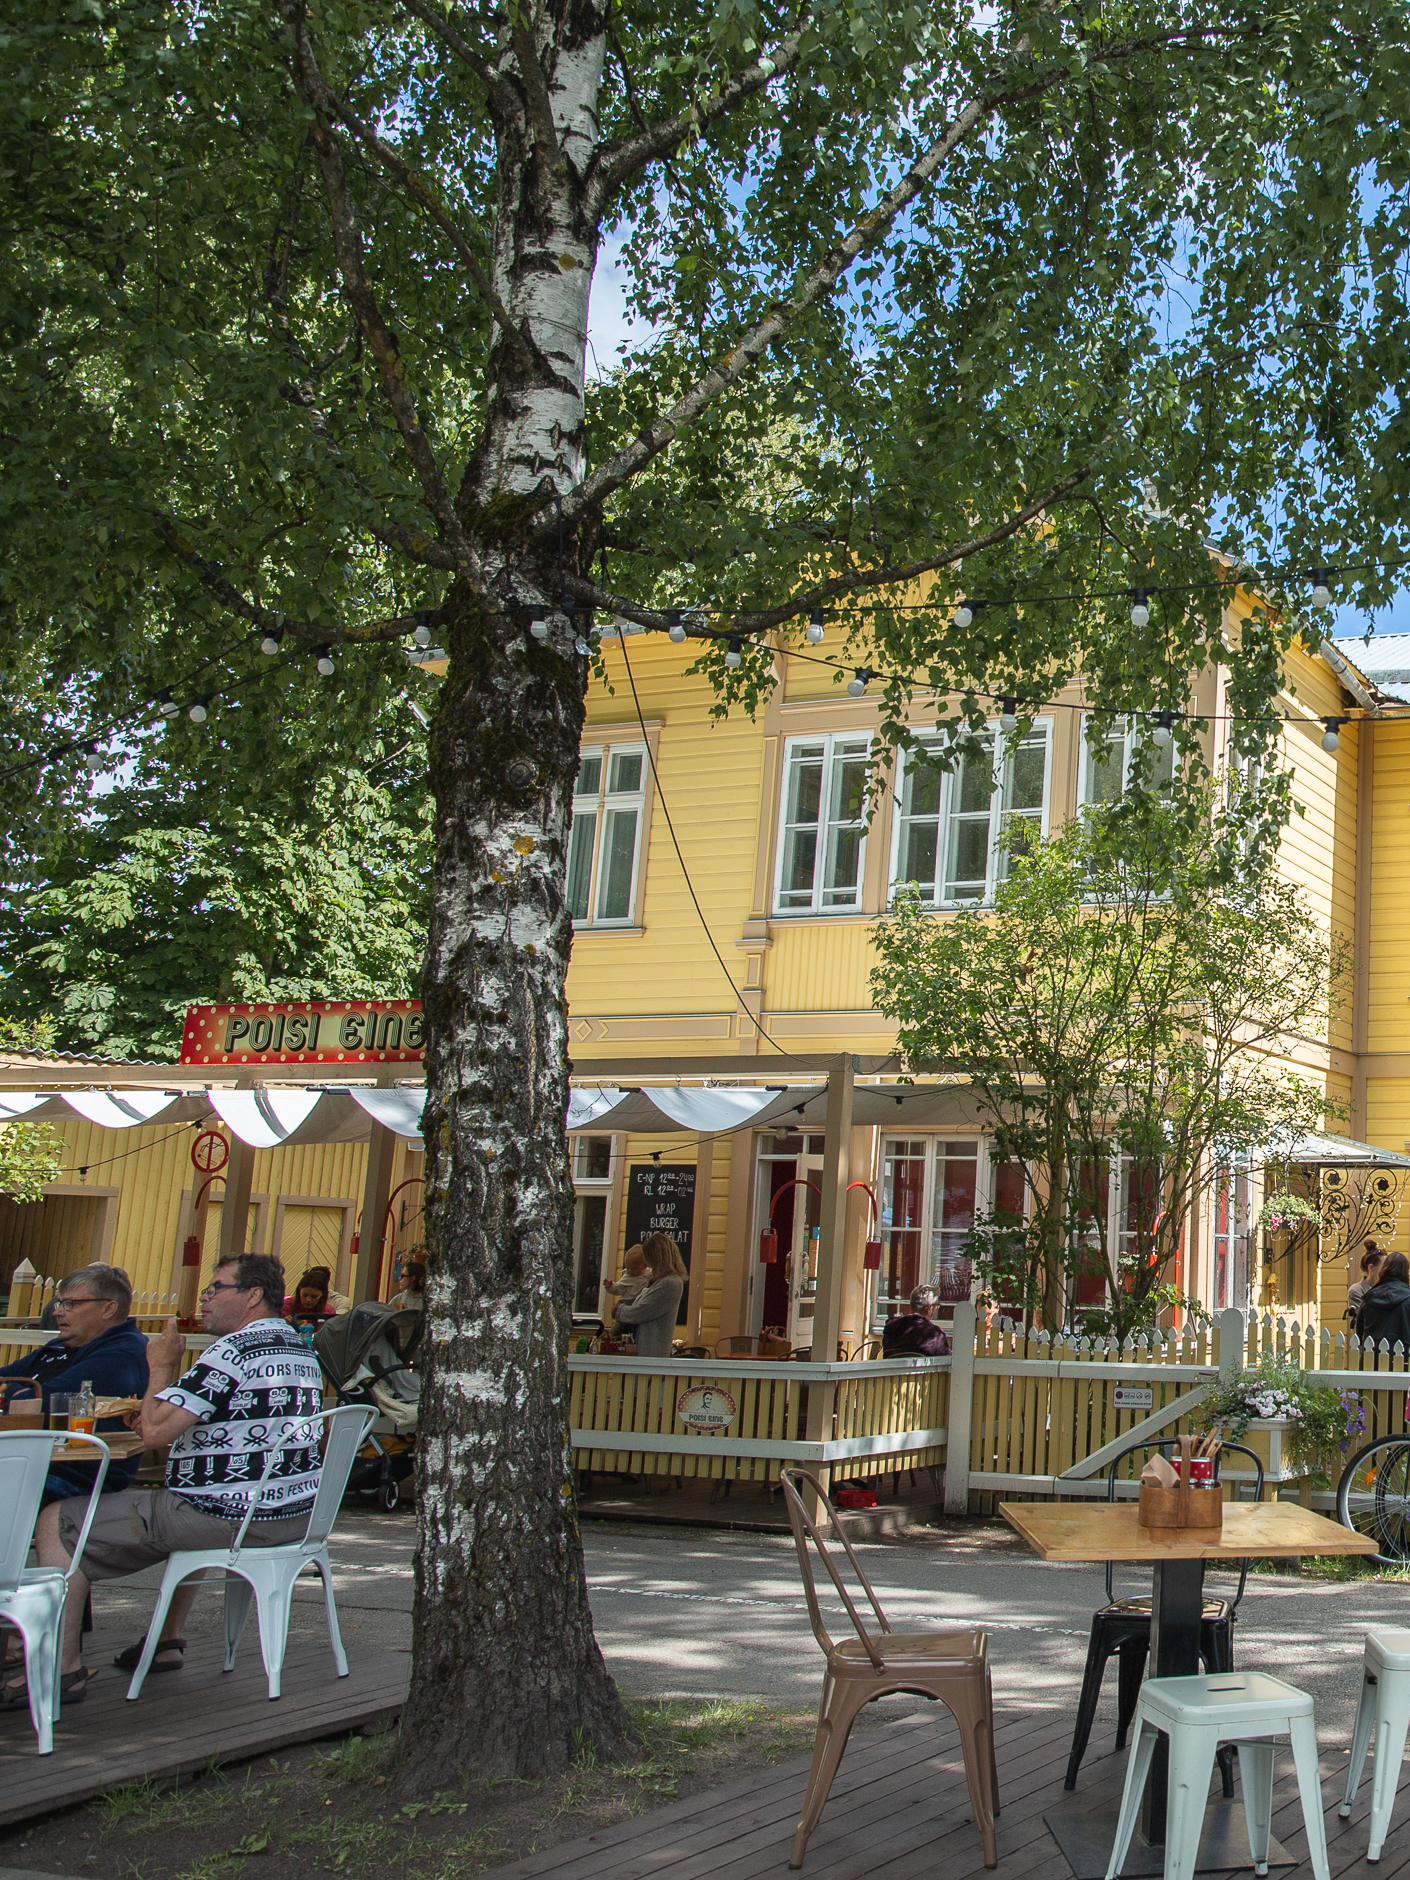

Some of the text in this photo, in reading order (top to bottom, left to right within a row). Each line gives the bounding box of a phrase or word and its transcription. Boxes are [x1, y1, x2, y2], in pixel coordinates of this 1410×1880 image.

[224, 1011, 425, 1053] POISI EINE
[655, 1203, 676, 1215] WRAP
[650, 1217, 679, 1229] BURGER
[688, 1413, 724, 1423] POISI EINE
[182, 1461, 191, 1469] 65
[233, 1456, 244, 1464] 65
